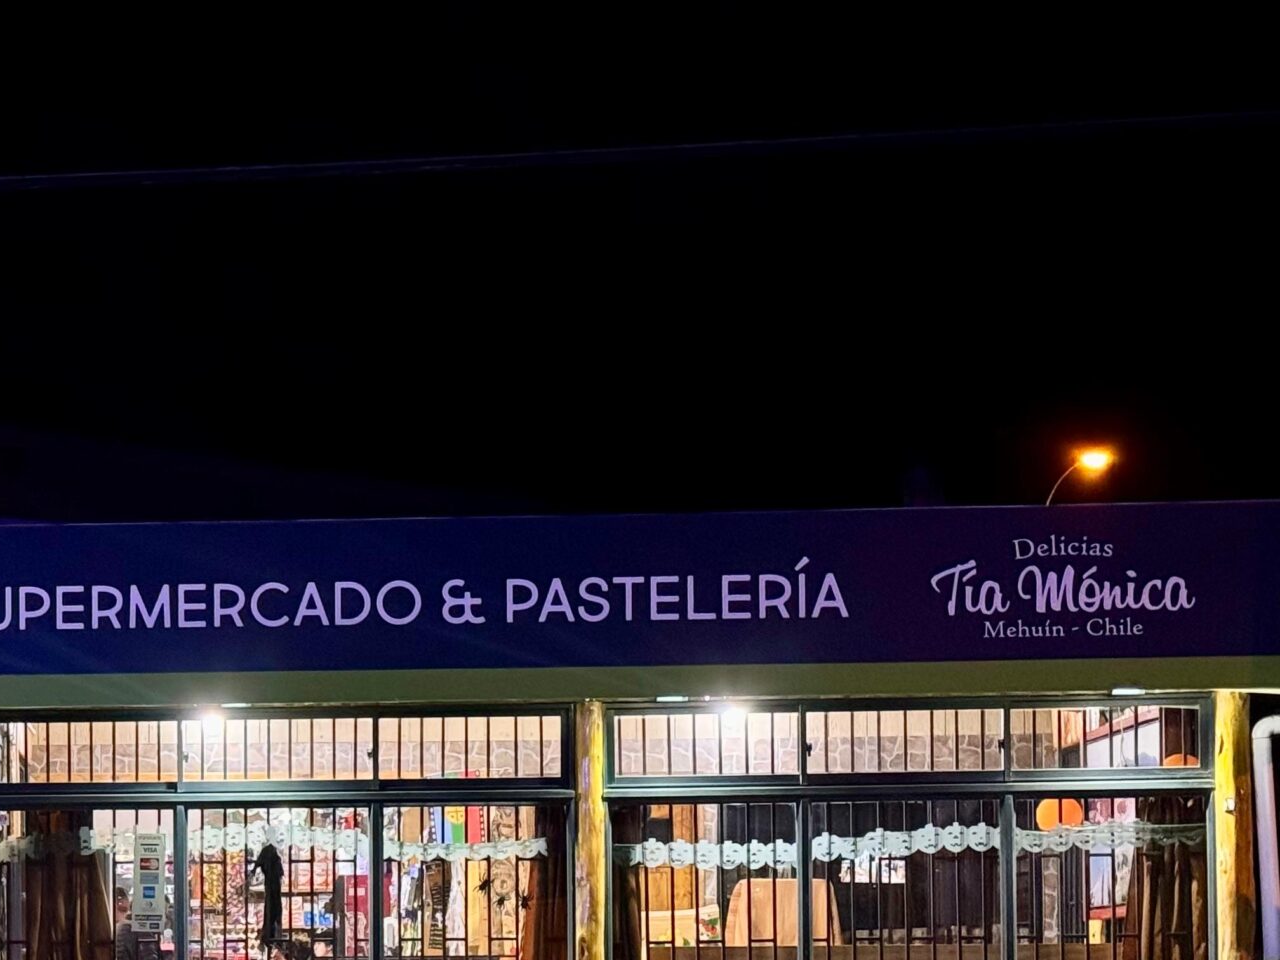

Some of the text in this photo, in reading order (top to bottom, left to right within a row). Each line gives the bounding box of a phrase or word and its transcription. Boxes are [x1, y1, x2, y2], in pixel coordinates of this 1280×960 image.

[1012, 534, 1114, 560] Delicias
[441, 578, 486, 625] &
[505, 556, 850, 624] PASTELERÍA
[930, 559, 1196, 617] Tía Mónica
[982, 619, 1066, 639] Mehuín
[1086, 617, 1145, 637] Chile
[142, 846, 158, 854] VISA
